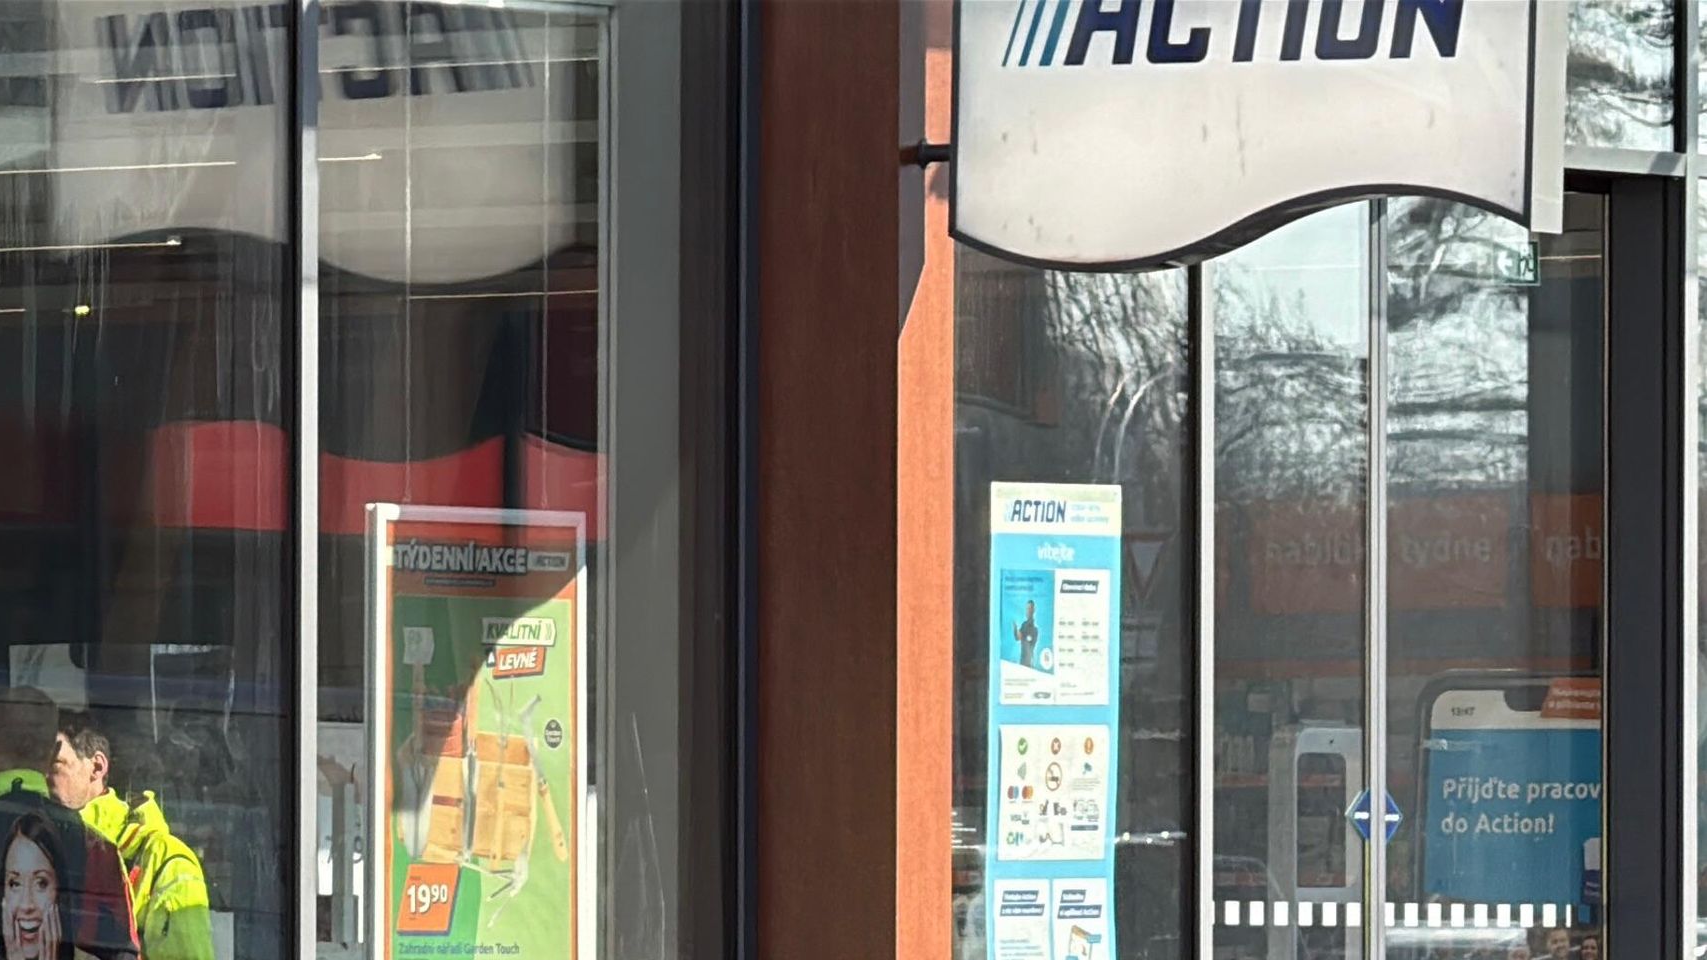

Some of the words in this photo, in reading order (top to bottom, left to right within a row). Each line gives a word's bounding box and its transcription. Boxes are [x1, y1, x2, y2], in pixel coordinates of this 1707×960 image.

[1011, 499, 1067, 523] ACTION
[396, 538, 475, 571] TÝDENNÍ
[477, 546, 527, 574] AKCE
[487, 619, 543, 640] KVALITNÍ
[498, 648, 538, 671] LEVNÉ
[1442, 775, 1521, 804] Přijďte
[1441, 812, 1469, 834] do
[1474, 811, 1555, 834] Action!
[495, 942, 520, 955] Touch
